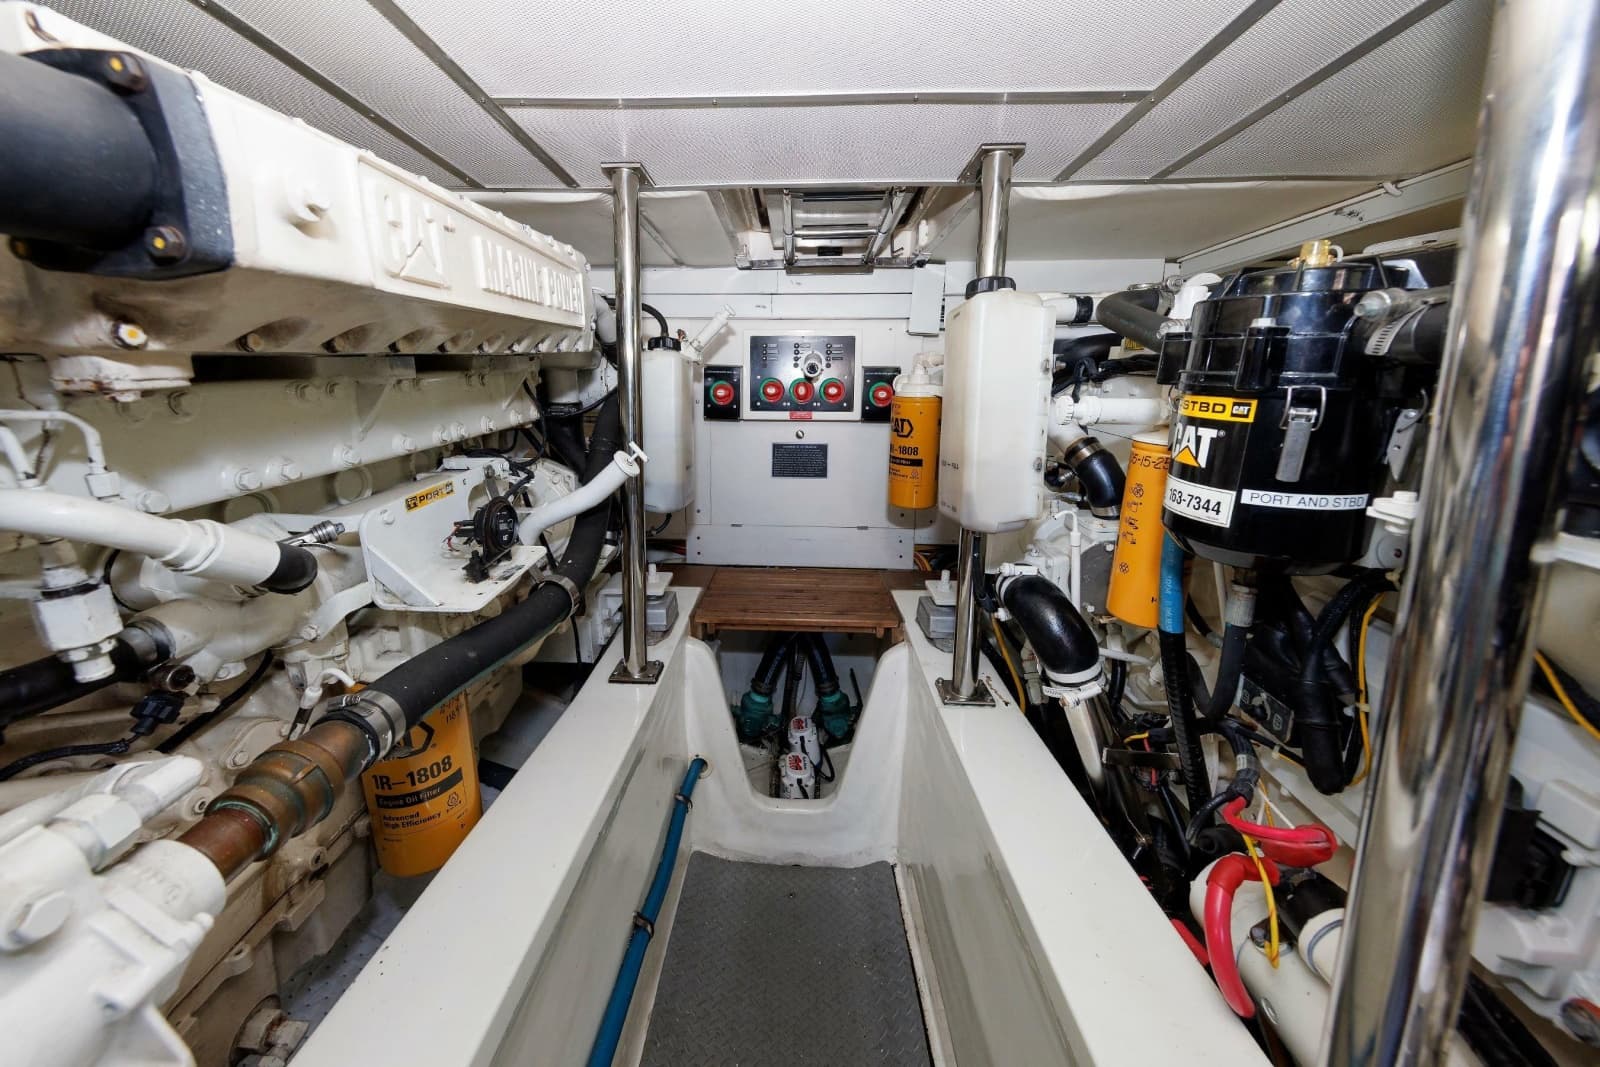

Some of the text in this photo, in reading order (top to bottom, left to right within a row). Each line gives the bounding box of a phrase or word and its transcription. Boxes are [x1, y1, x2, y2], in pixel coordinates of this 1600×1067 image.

[1182, 400, 1227, 414] STBD
[1171, 421, 1219, 469] CAT
[418, 487, 446, 504] PORT
[1169, 487, 1222, 516] 163-7344
[1250, 492, 1365, 508] PORT AND STBD
[372, 754, 453, 791] 1R-1808
